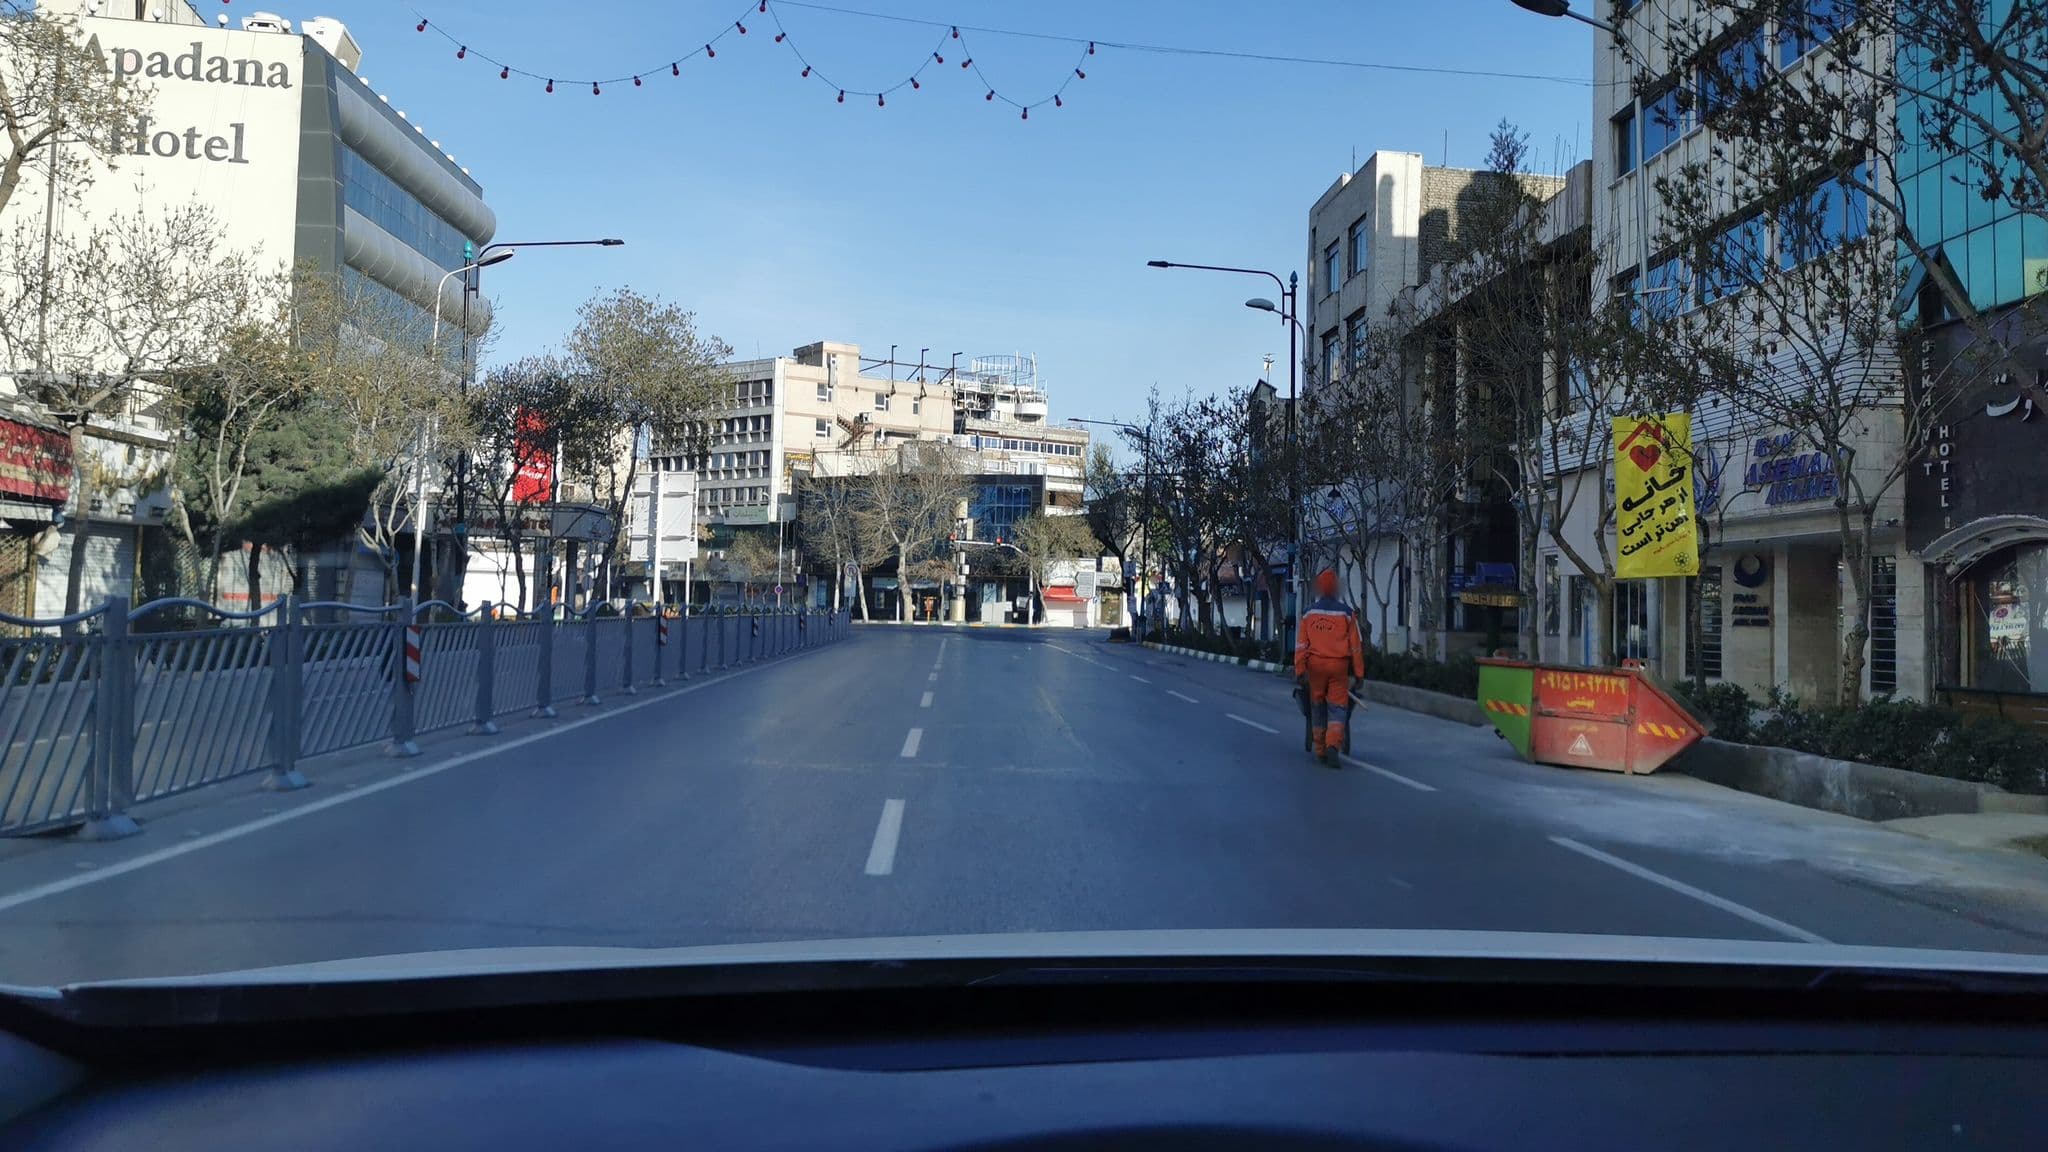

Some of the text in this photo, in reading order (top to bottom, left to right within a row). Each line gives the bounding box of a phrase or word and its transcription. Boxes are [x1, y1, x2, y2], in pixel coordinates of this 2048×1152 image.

[82, 33, 293, 92] Apadana
[110, 114, 249, 164] Hotel
[1622, 463, 1687, 511] خانه
[1940, 426, 1950, 508] HOTEL
[1622, 486, 1688, 537] از هر جایی
[1621, 532, 1653, 556] است
